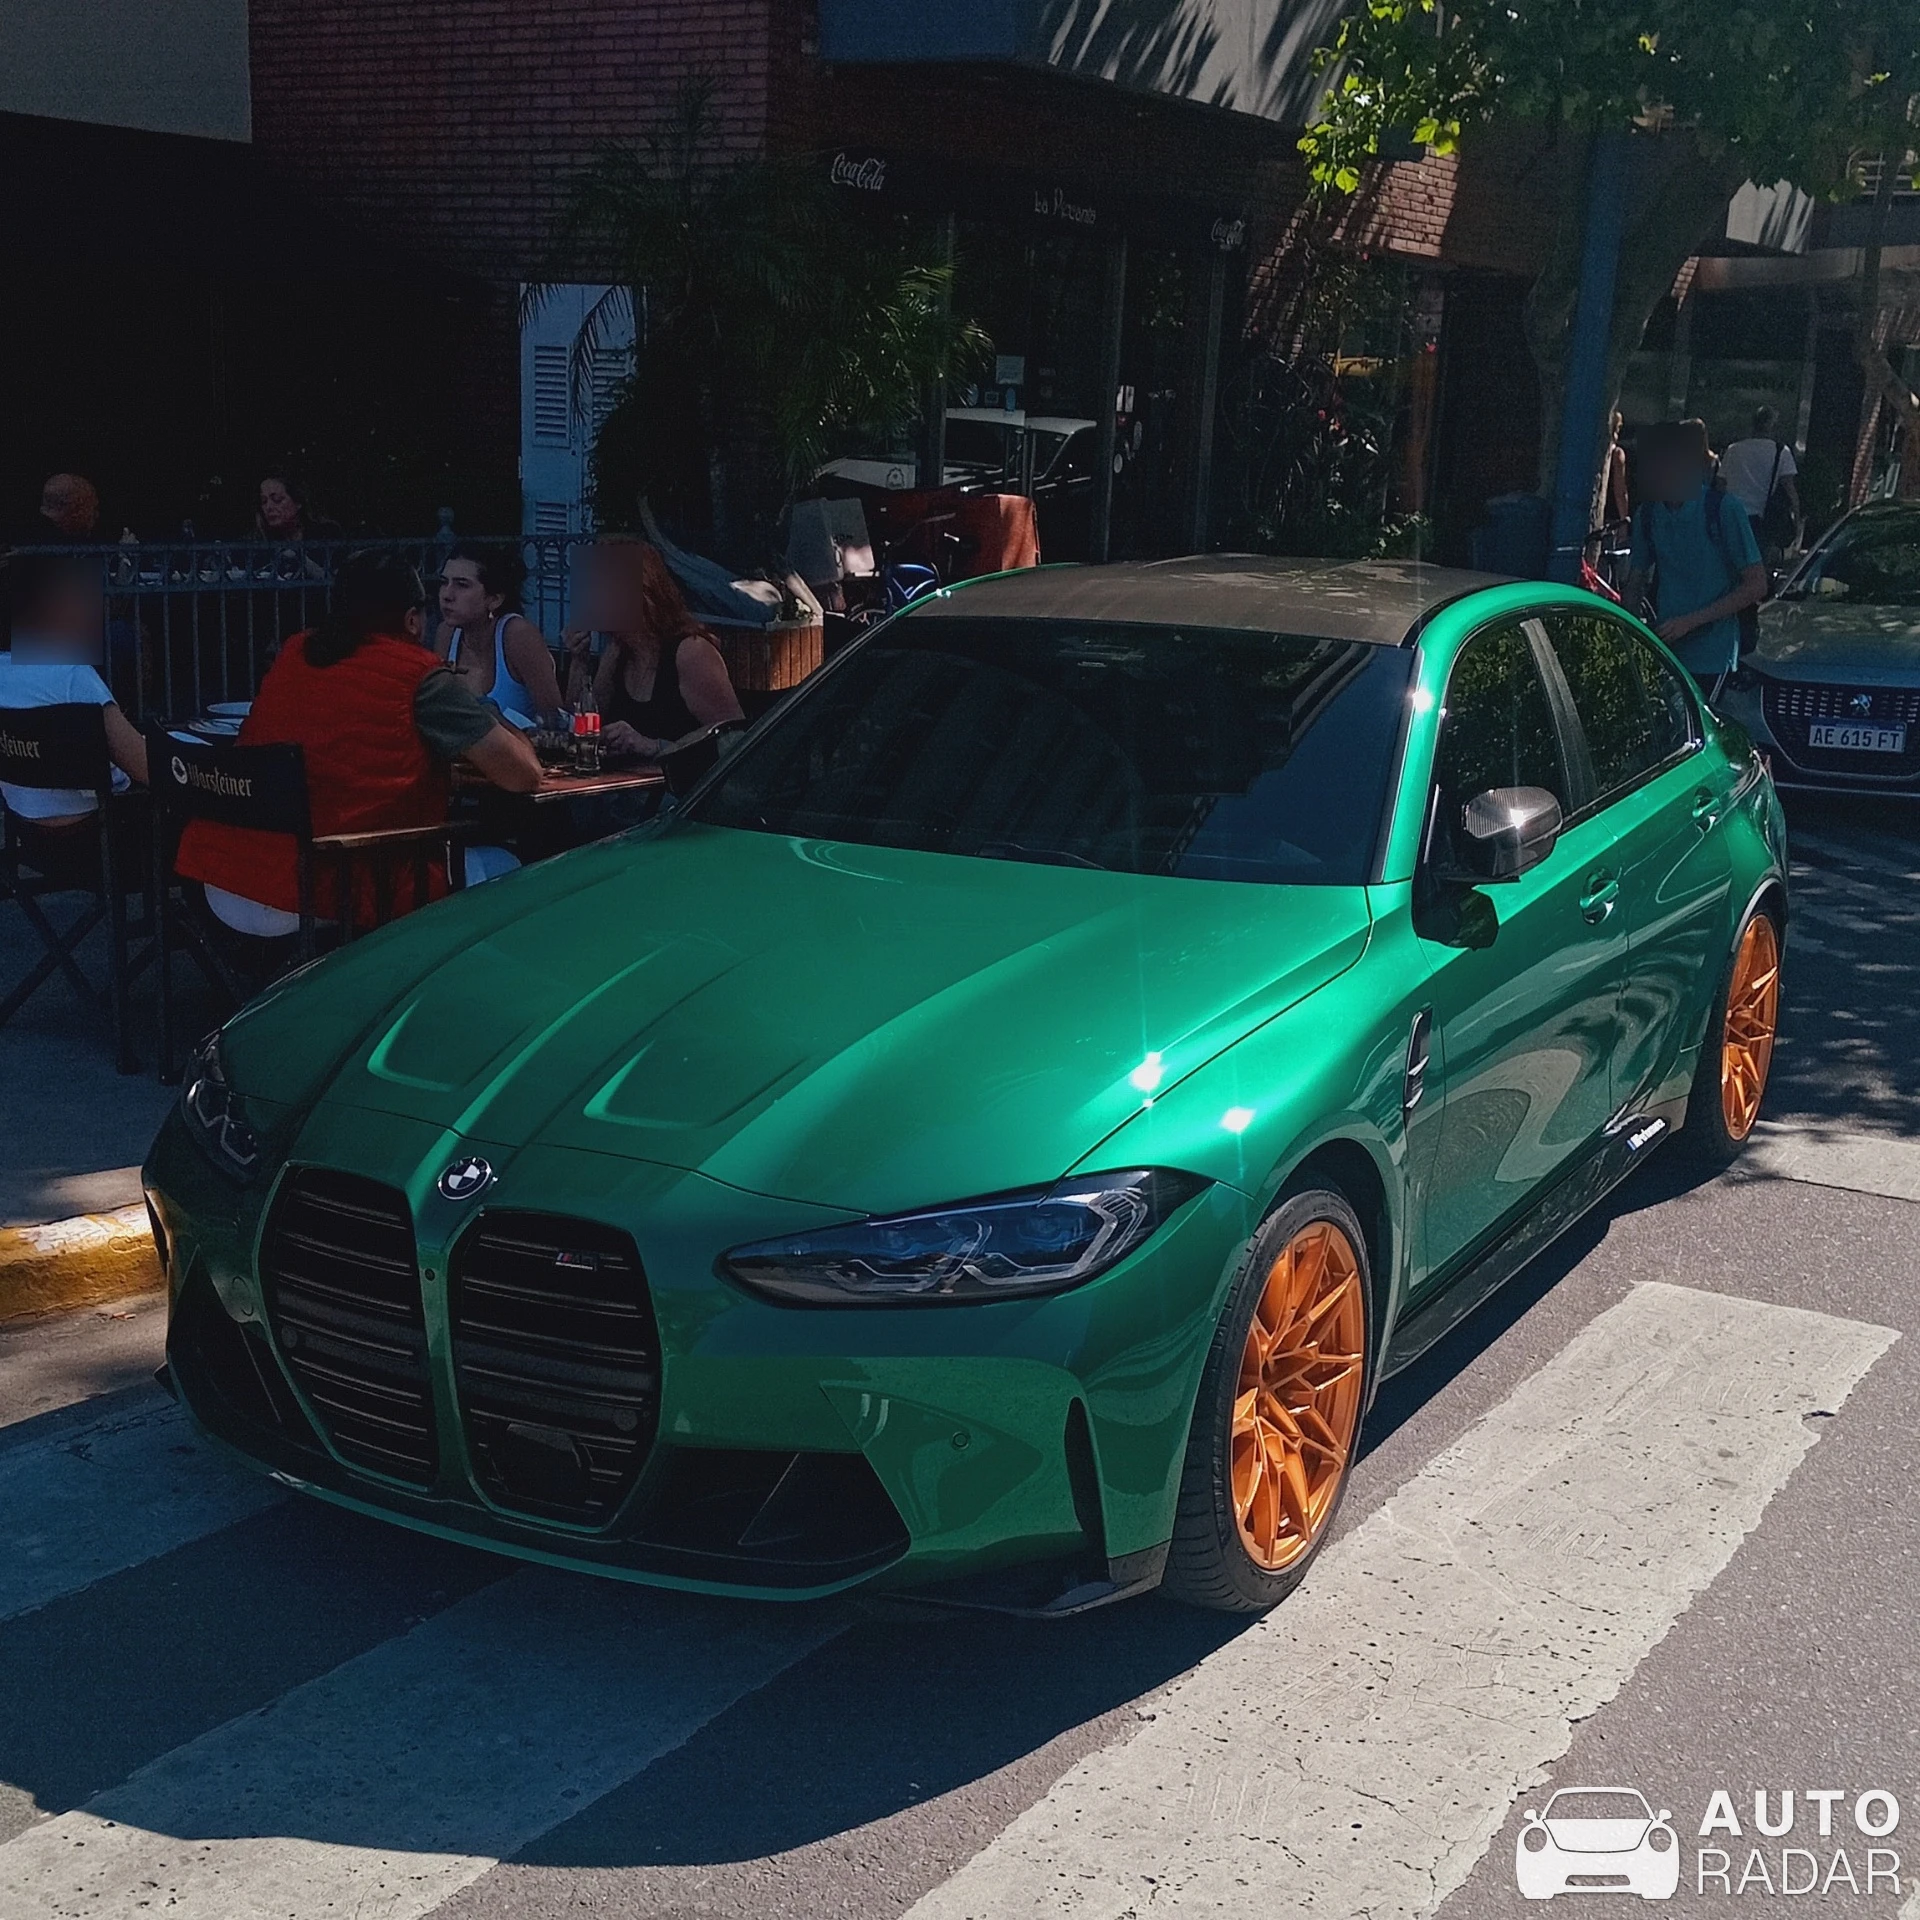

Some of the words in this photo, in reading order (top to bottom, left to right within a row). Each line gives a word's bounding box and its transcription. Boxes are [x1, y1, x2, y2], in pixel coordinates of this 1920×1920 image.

[1813, 727, 1835, 745] AE
[1841, 729, 1872, 747] 615
[1878, 731, 1899, 749] FT
[186, 762, 252, 797] Warsteiner
